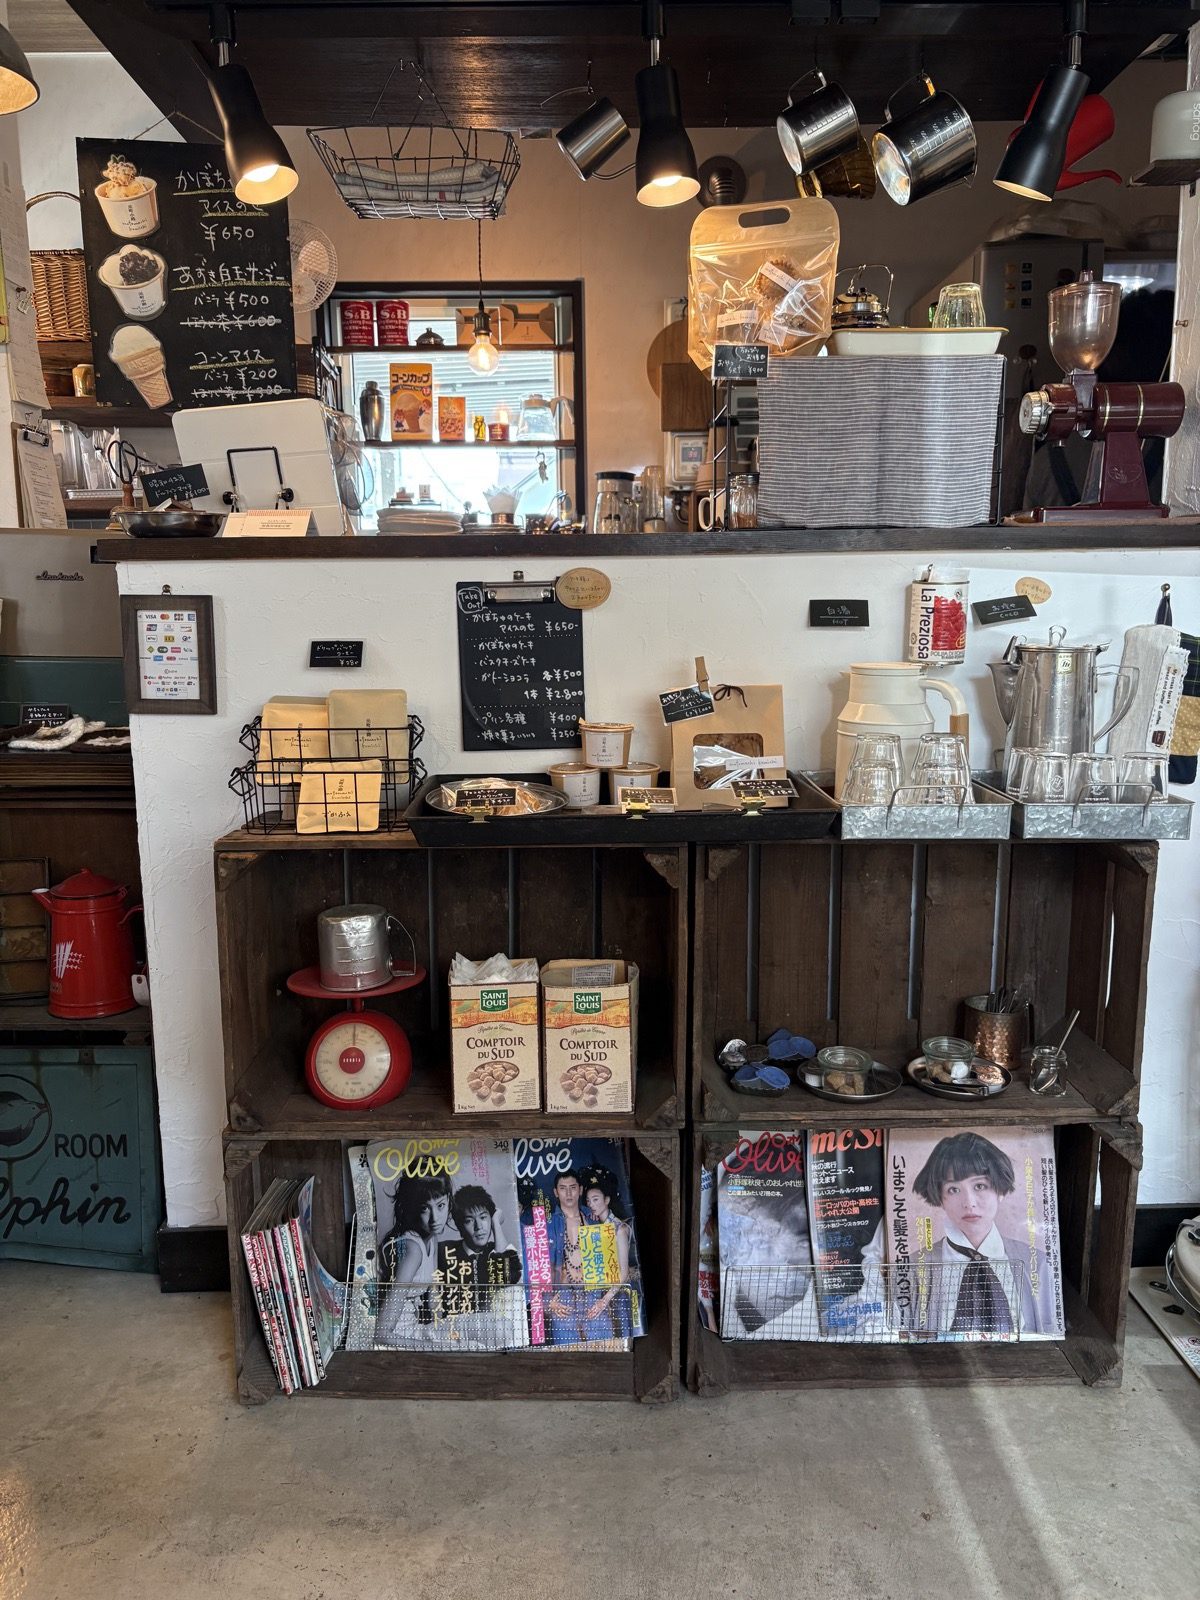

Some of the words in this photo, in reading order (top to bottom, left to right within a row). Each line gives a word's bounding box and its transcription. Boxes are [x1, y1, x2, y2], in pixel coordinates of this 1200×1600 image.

[200, 222, 255, 252] ¥650
[224, 291, 270, 311] ¥500
[392, 372, 431, 384] コーンカップ
[460, 592, 478, 601] Take
[920, 588, 937, 602] La
[467, 602, 481, 610] Out
[917, 606, 935, 659] Preziosa
[483, 992, 507, 1000] SAINT
[575, 994, 600, 1002] SAINT
[482, 999, 507, 1008] LOUIS
[575, 1002, 600, 1010] LOUIS
[466, 1036, 526, 1049] COMPTOIR
[559, 1038, 618, 1050] COMPTOIR
[491, 1048, 515, 1060] SUD
[584, 1050, 608, 1062] SUD
[54, 1133, 128, 1158] ROOM
[373, 1139, 461, 1182] Olive
